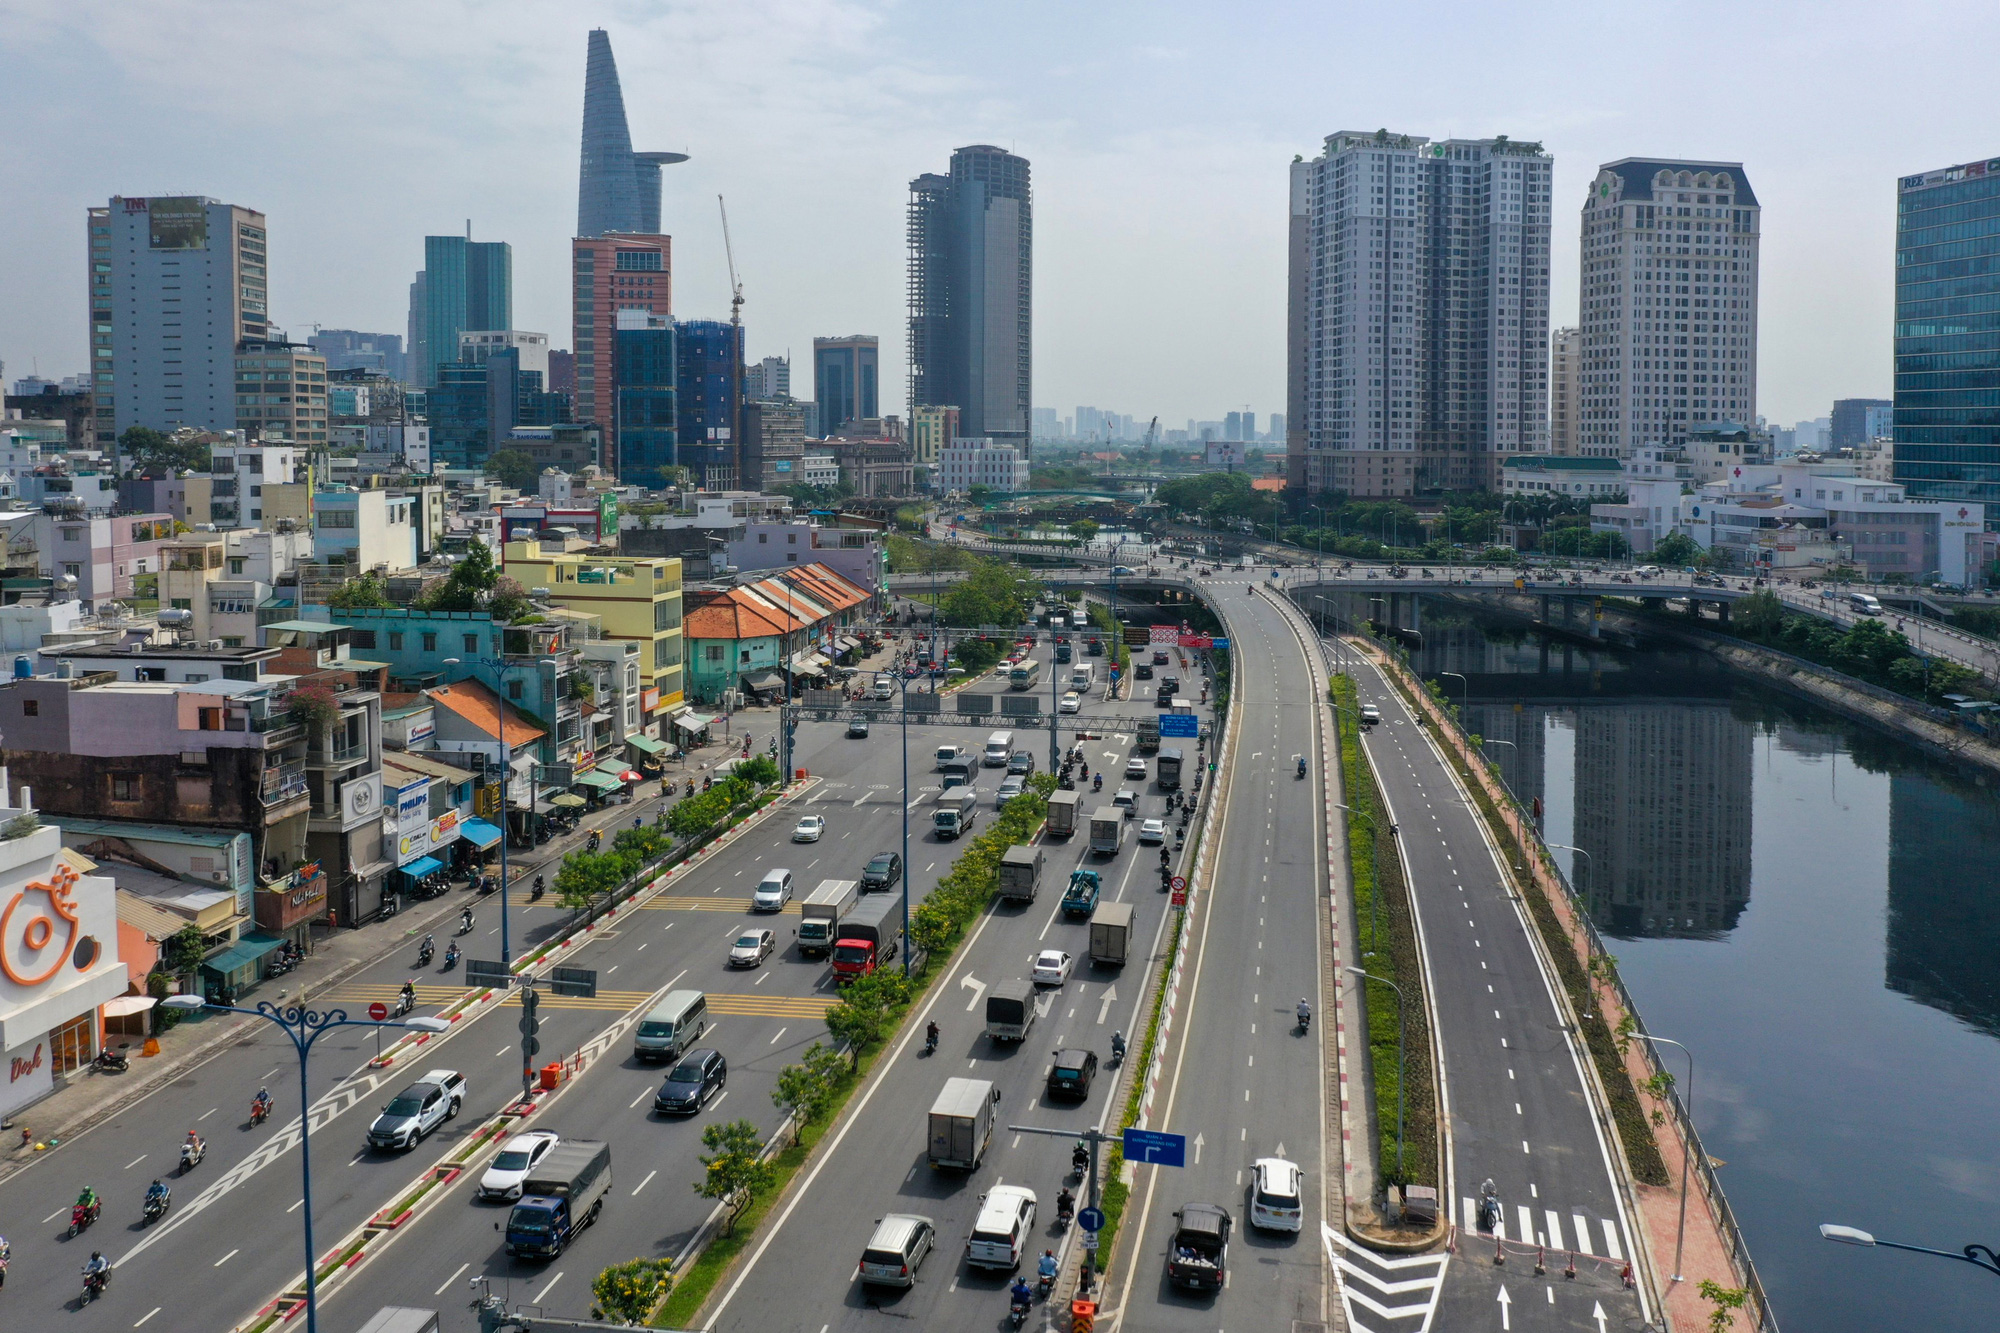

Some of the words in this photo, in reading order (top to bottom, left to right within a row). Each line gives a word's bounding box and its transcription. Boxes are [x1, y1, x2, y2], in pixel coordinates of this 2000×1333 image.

[1966, 161, 1985, 176] FE
[1904, 175, 1924, 188] REE
[123, 197, 146, 210] TNR
[400, 793, 427, 813] PHILIPS
